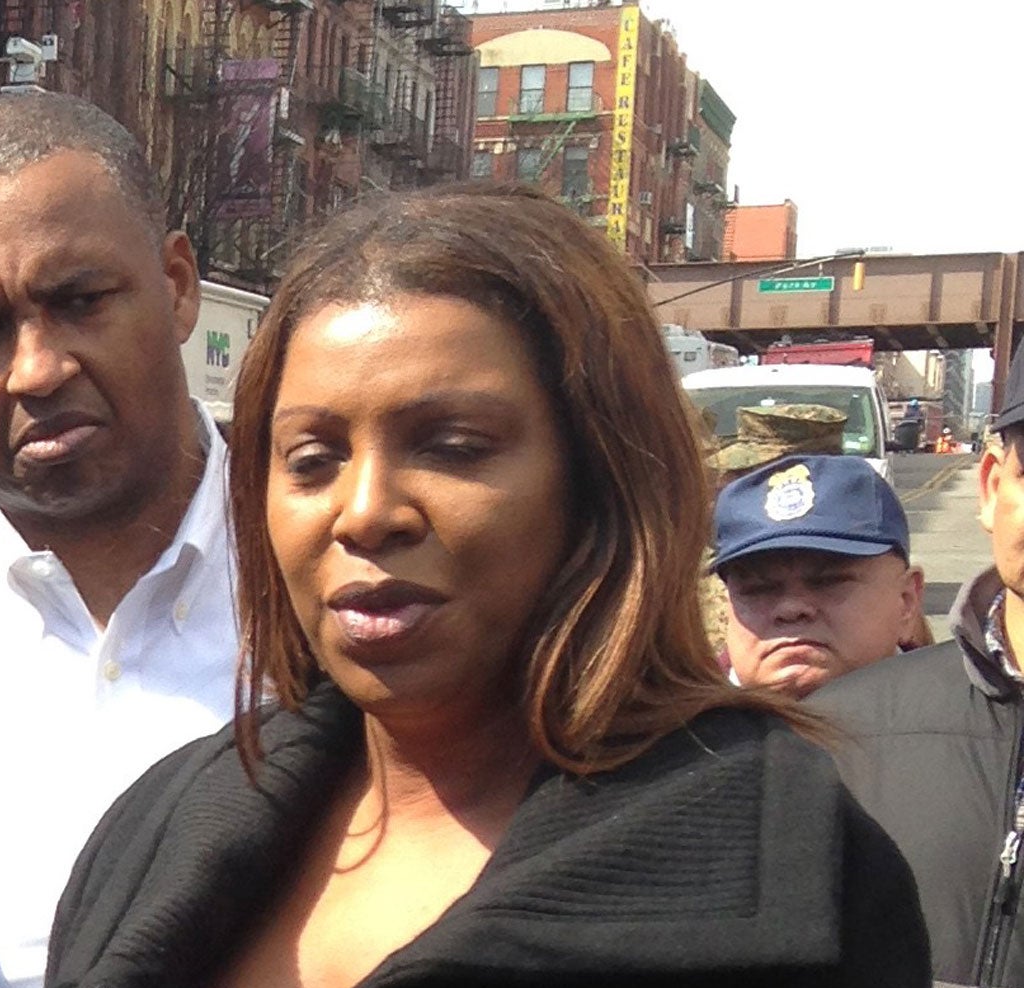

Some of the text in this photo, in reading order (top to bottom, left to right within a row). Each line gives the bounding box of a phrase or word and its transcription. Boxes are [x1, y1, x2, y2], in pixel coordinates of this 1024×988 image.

[608, 17, 635, 241] CAFE RESTAURA
[206, 329, 230, 368] NYC
